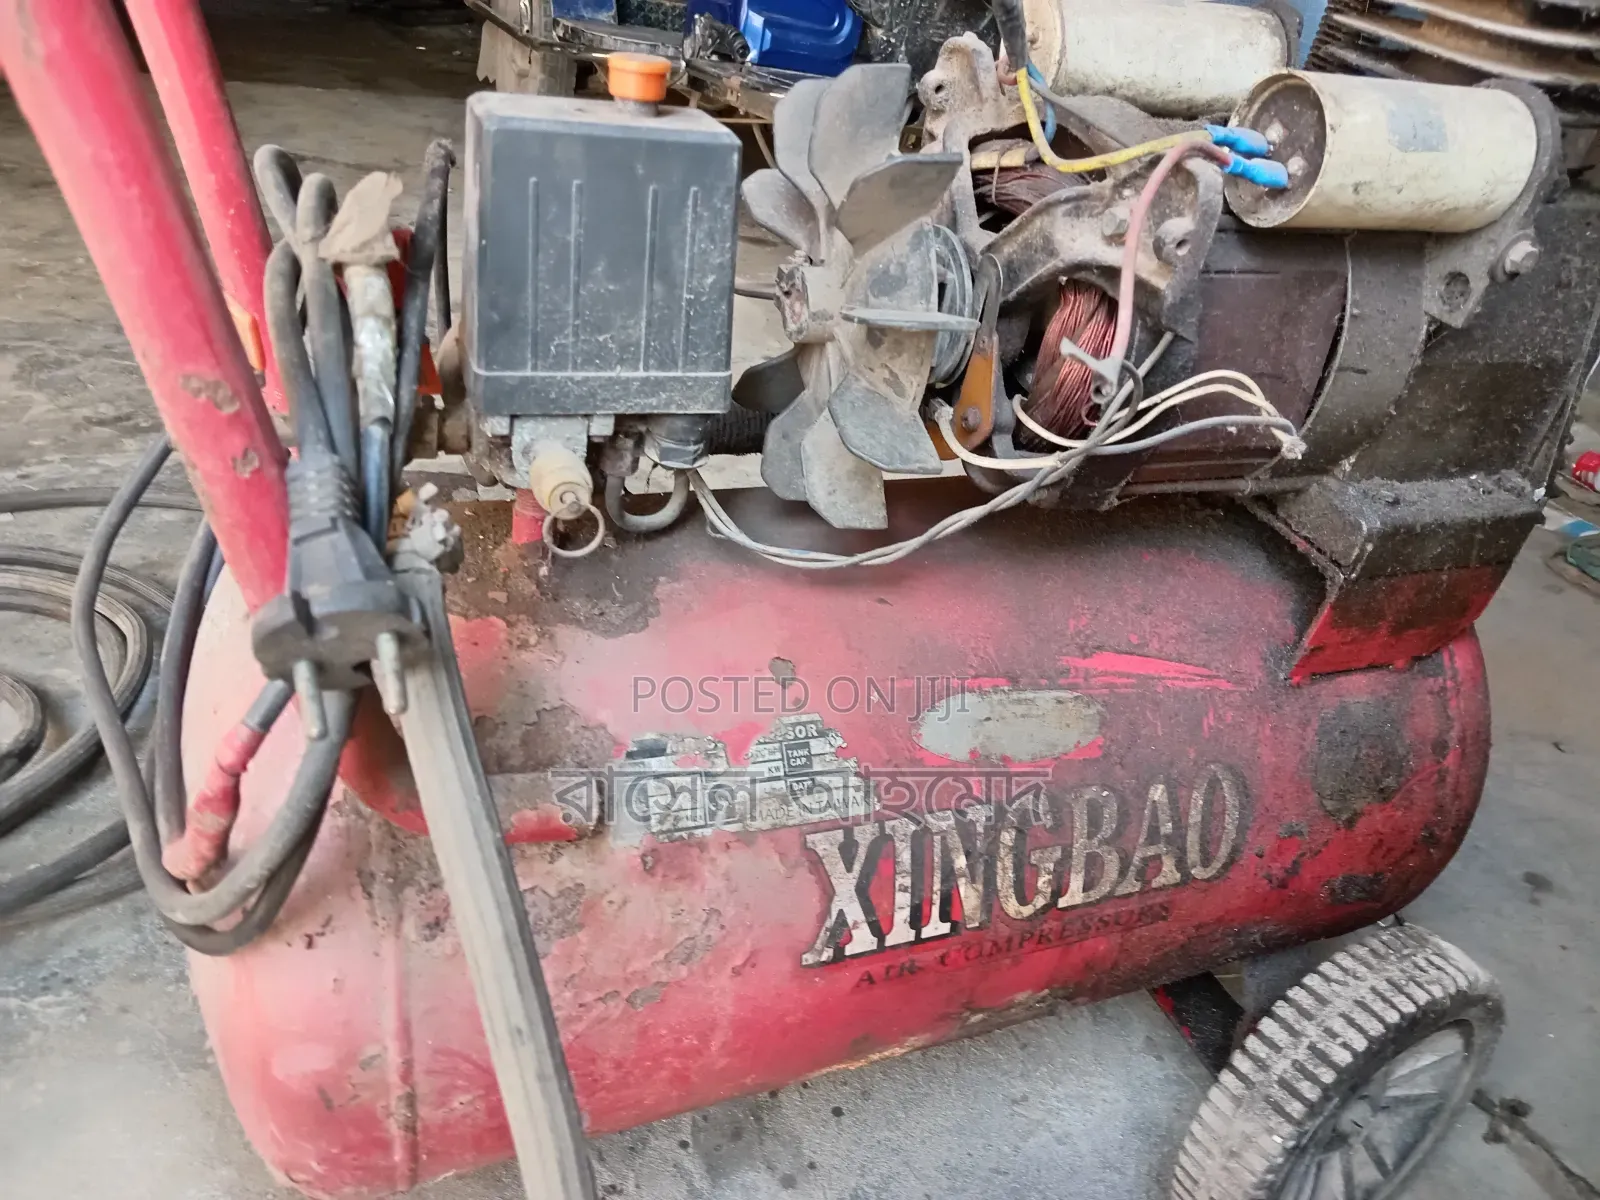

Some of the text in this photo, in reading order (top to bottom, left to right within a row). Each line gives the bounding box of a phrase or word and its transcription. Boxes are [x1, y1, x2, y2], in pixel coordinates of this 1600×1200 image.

[786, 748, 811, 758] TANK
[799, 762, 1252, 967] XINGBAO
[855, 957, 922, 988] AIR
